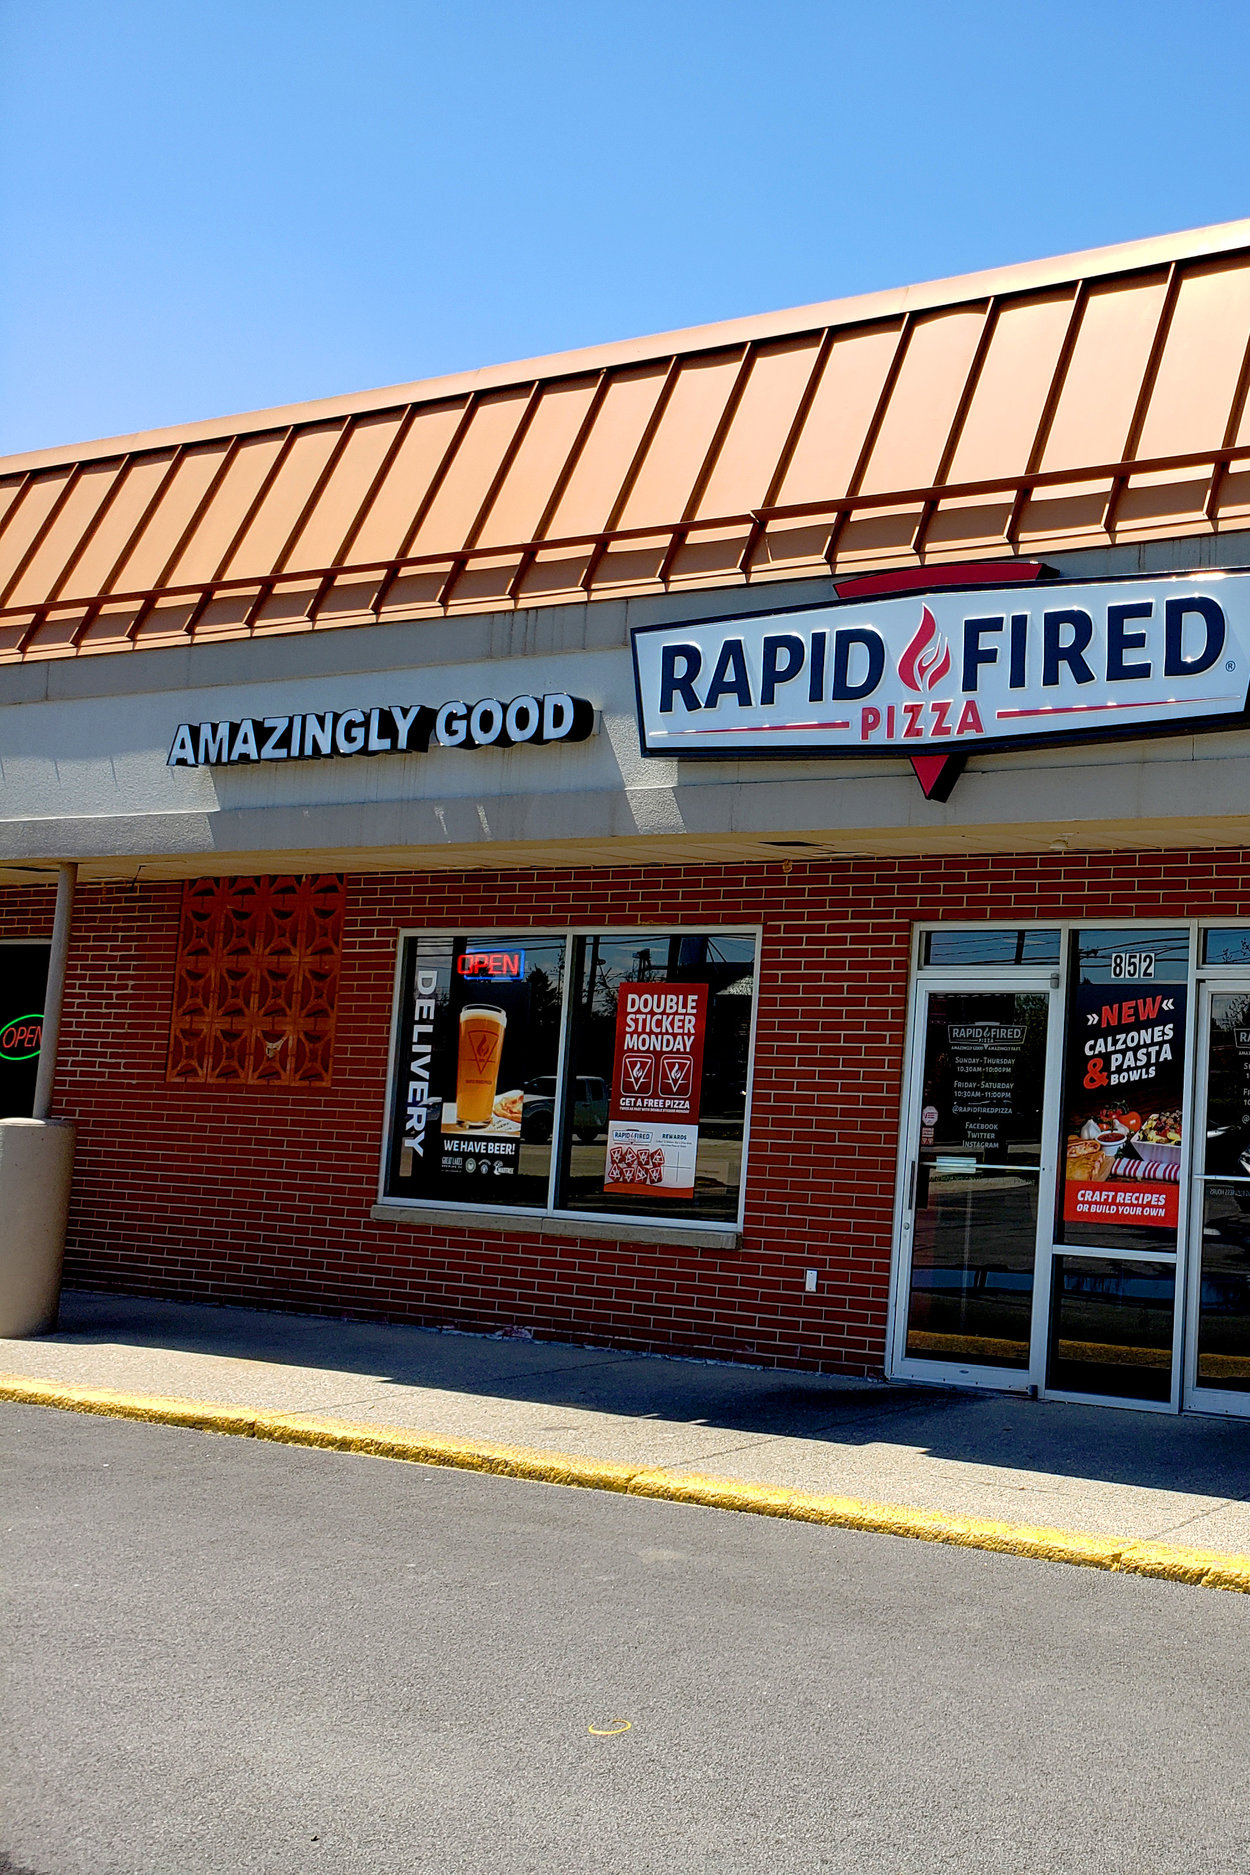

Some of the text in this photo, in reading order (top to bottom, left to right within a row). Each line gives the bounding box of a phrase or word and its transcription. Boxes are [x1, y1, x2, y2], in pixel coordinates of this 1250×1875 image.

[658, 626, 886, 714] RAPID
[960, 595, 1227, 693] FIRED
[166, 692, 582, 767] AMAZINGLY GOOD
[859, 699, 985, 741] PIZZA
[457, 954, 519, 975] OPEN
[1112, 954, 1154, 978] 852
[627, 994, 698, 1014] DOUBLE
[1101, 995, 1162, 1028] NEW
[626, 1014, 695, 1034] STICKER
[953, 1028, 1021, 1038] RAPID FIRED
[624, 1034, 694, 1052] MONDAY
[1084, 1024, 1174, 1056] CALZONES
[404, 970, 439, 1158] DELIVERY
[1083, 1043, 1172, 1089] & PASTA
[1110, 1066, 1156, 1085] BOWLS
[620, 1098, 690, 1109] GET A FREE PIZZA
[444, 1140, 516, 1155] WE HAVE BEER!
[1078, 1190, 1166, 1205] CRAFT RECIPES
[1077, 1204, 1165, 1216] OR BUILD YOUR OWN
